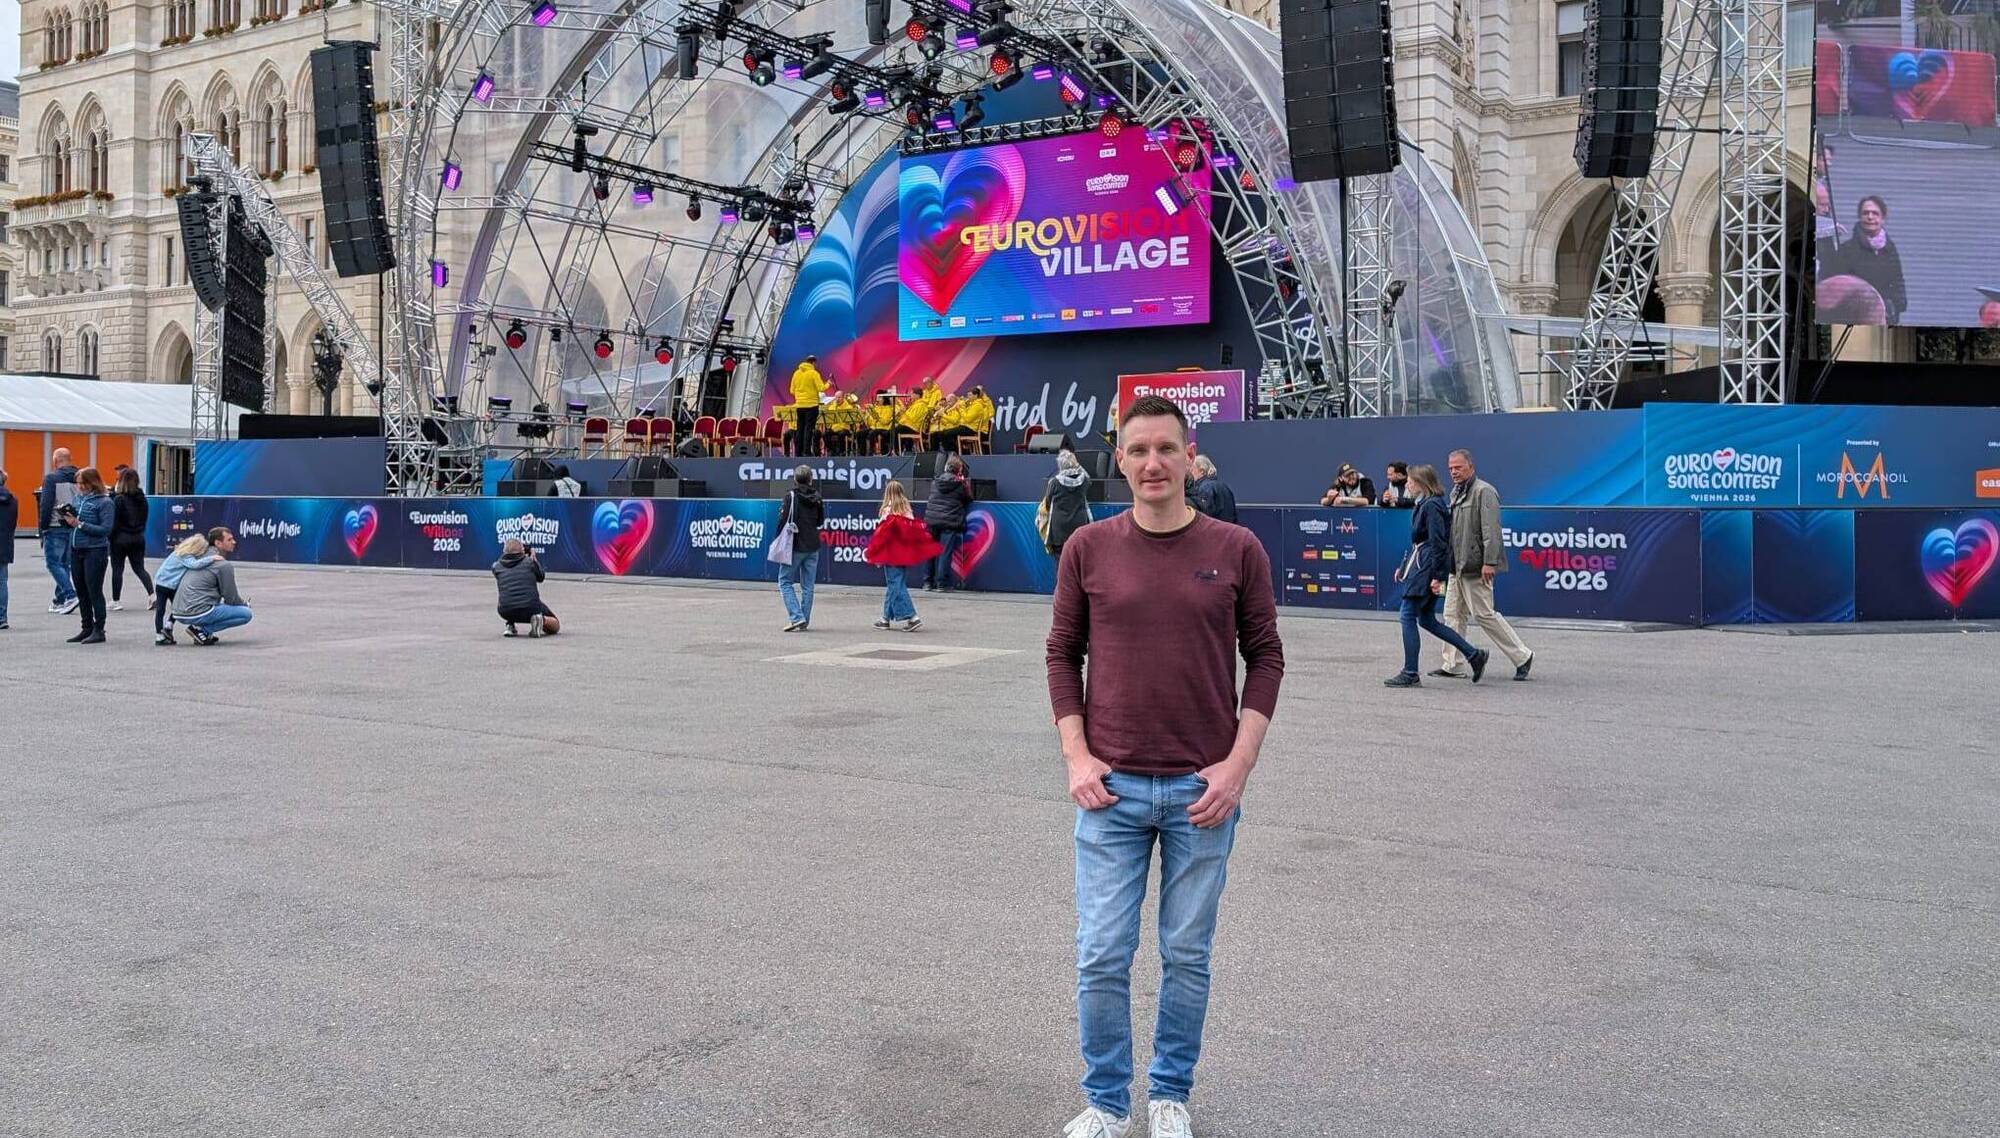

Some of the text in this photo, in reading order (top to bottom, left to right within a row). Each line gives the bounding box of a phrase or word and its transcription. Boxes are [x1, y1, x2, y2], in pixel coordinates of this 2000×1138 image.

[960, 208, 1189, 256] EUROVISION
[1040, 236, 1190, 277] VILLAGE
[996, 382, 1050, 432] ited
[1062, 381, 1097, 439] by
[1667, 472, 1780, 489] SONG CONTEST
[1816, 472, 1909, 483] MOROCCANOIL
[1691, 494, 1756, 502] VIENNA 2026
[409, 510, 469, 525] Eurovision
[240, 518, 301, 540] United by Music
[520, 531, 557, 545] CONTEST
[1501, 527, 1628, 549] Eurovision
[433, 537, 461, 551] 2026
[691, 533, 762, 549] SONG CONTEST
[1520, 548, 1617, 573] Village
[1545, 569, 1608, 591] 2026
